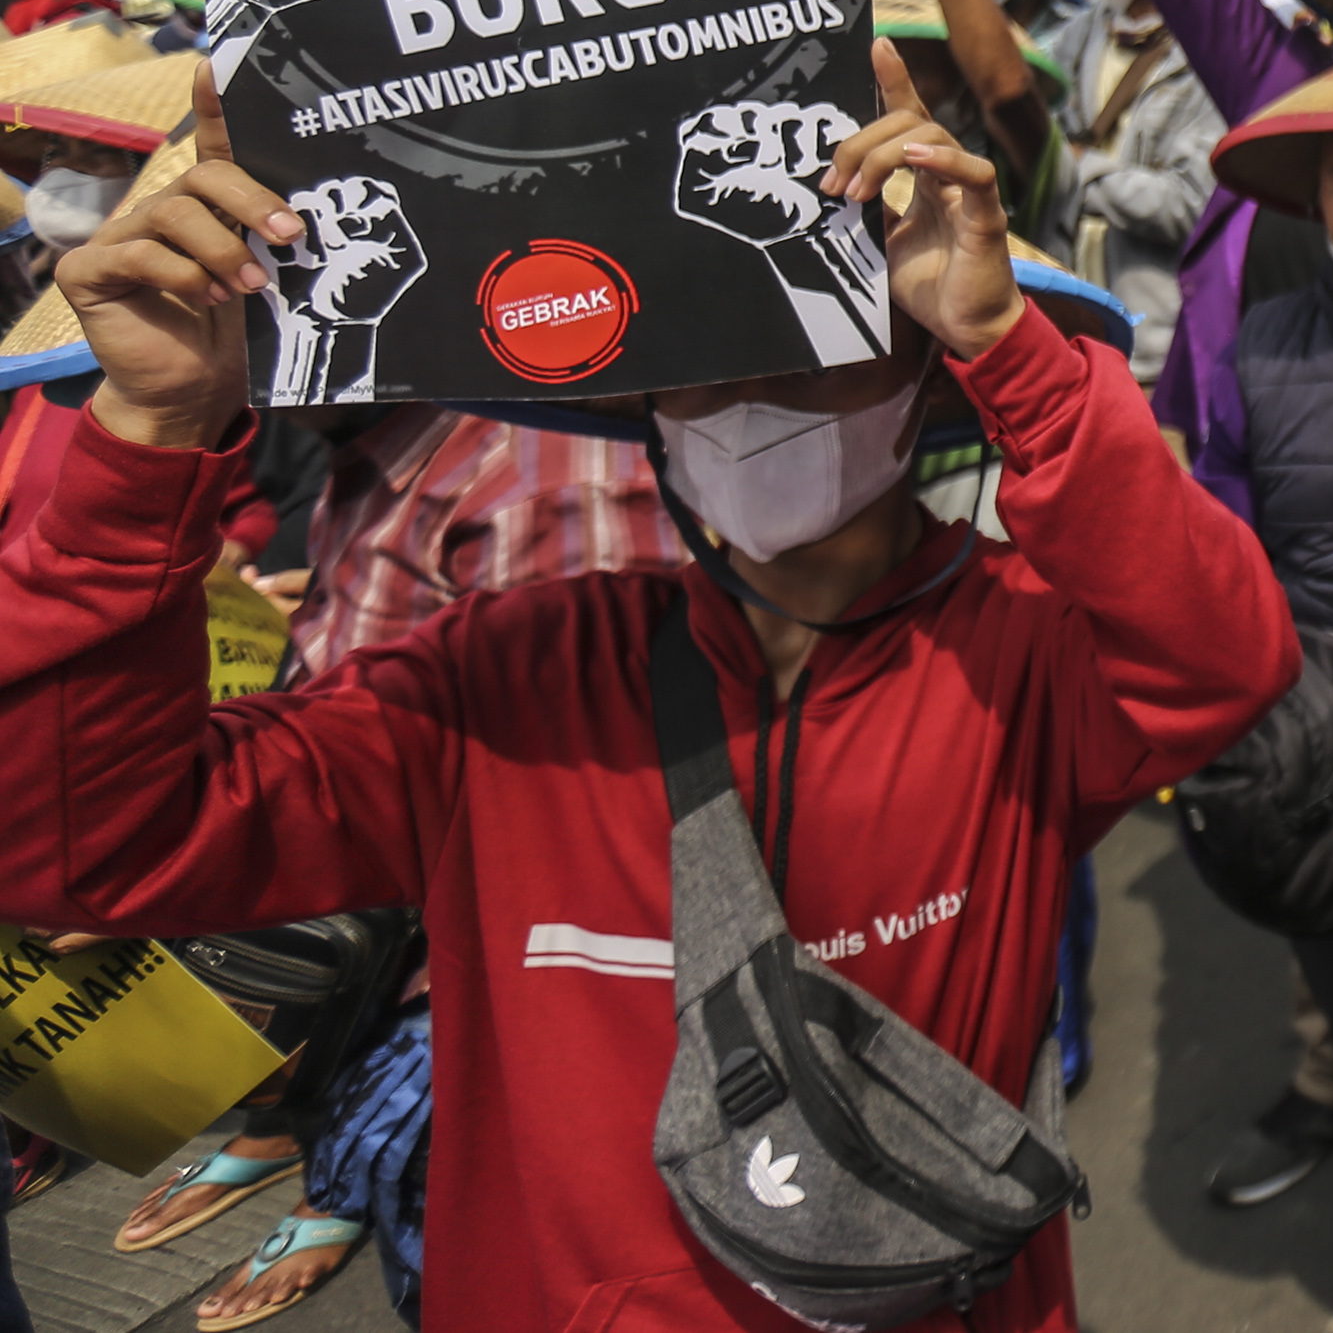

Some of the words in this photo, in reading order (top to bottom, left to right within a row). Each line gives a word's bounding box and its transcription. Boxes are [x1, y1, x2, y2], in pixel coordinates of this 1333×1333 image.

[501, 286, 611, 331] GEBRAK
[804, 929, 867, 962] ouis
[13, 936, 165, 1061] TANAH!!
